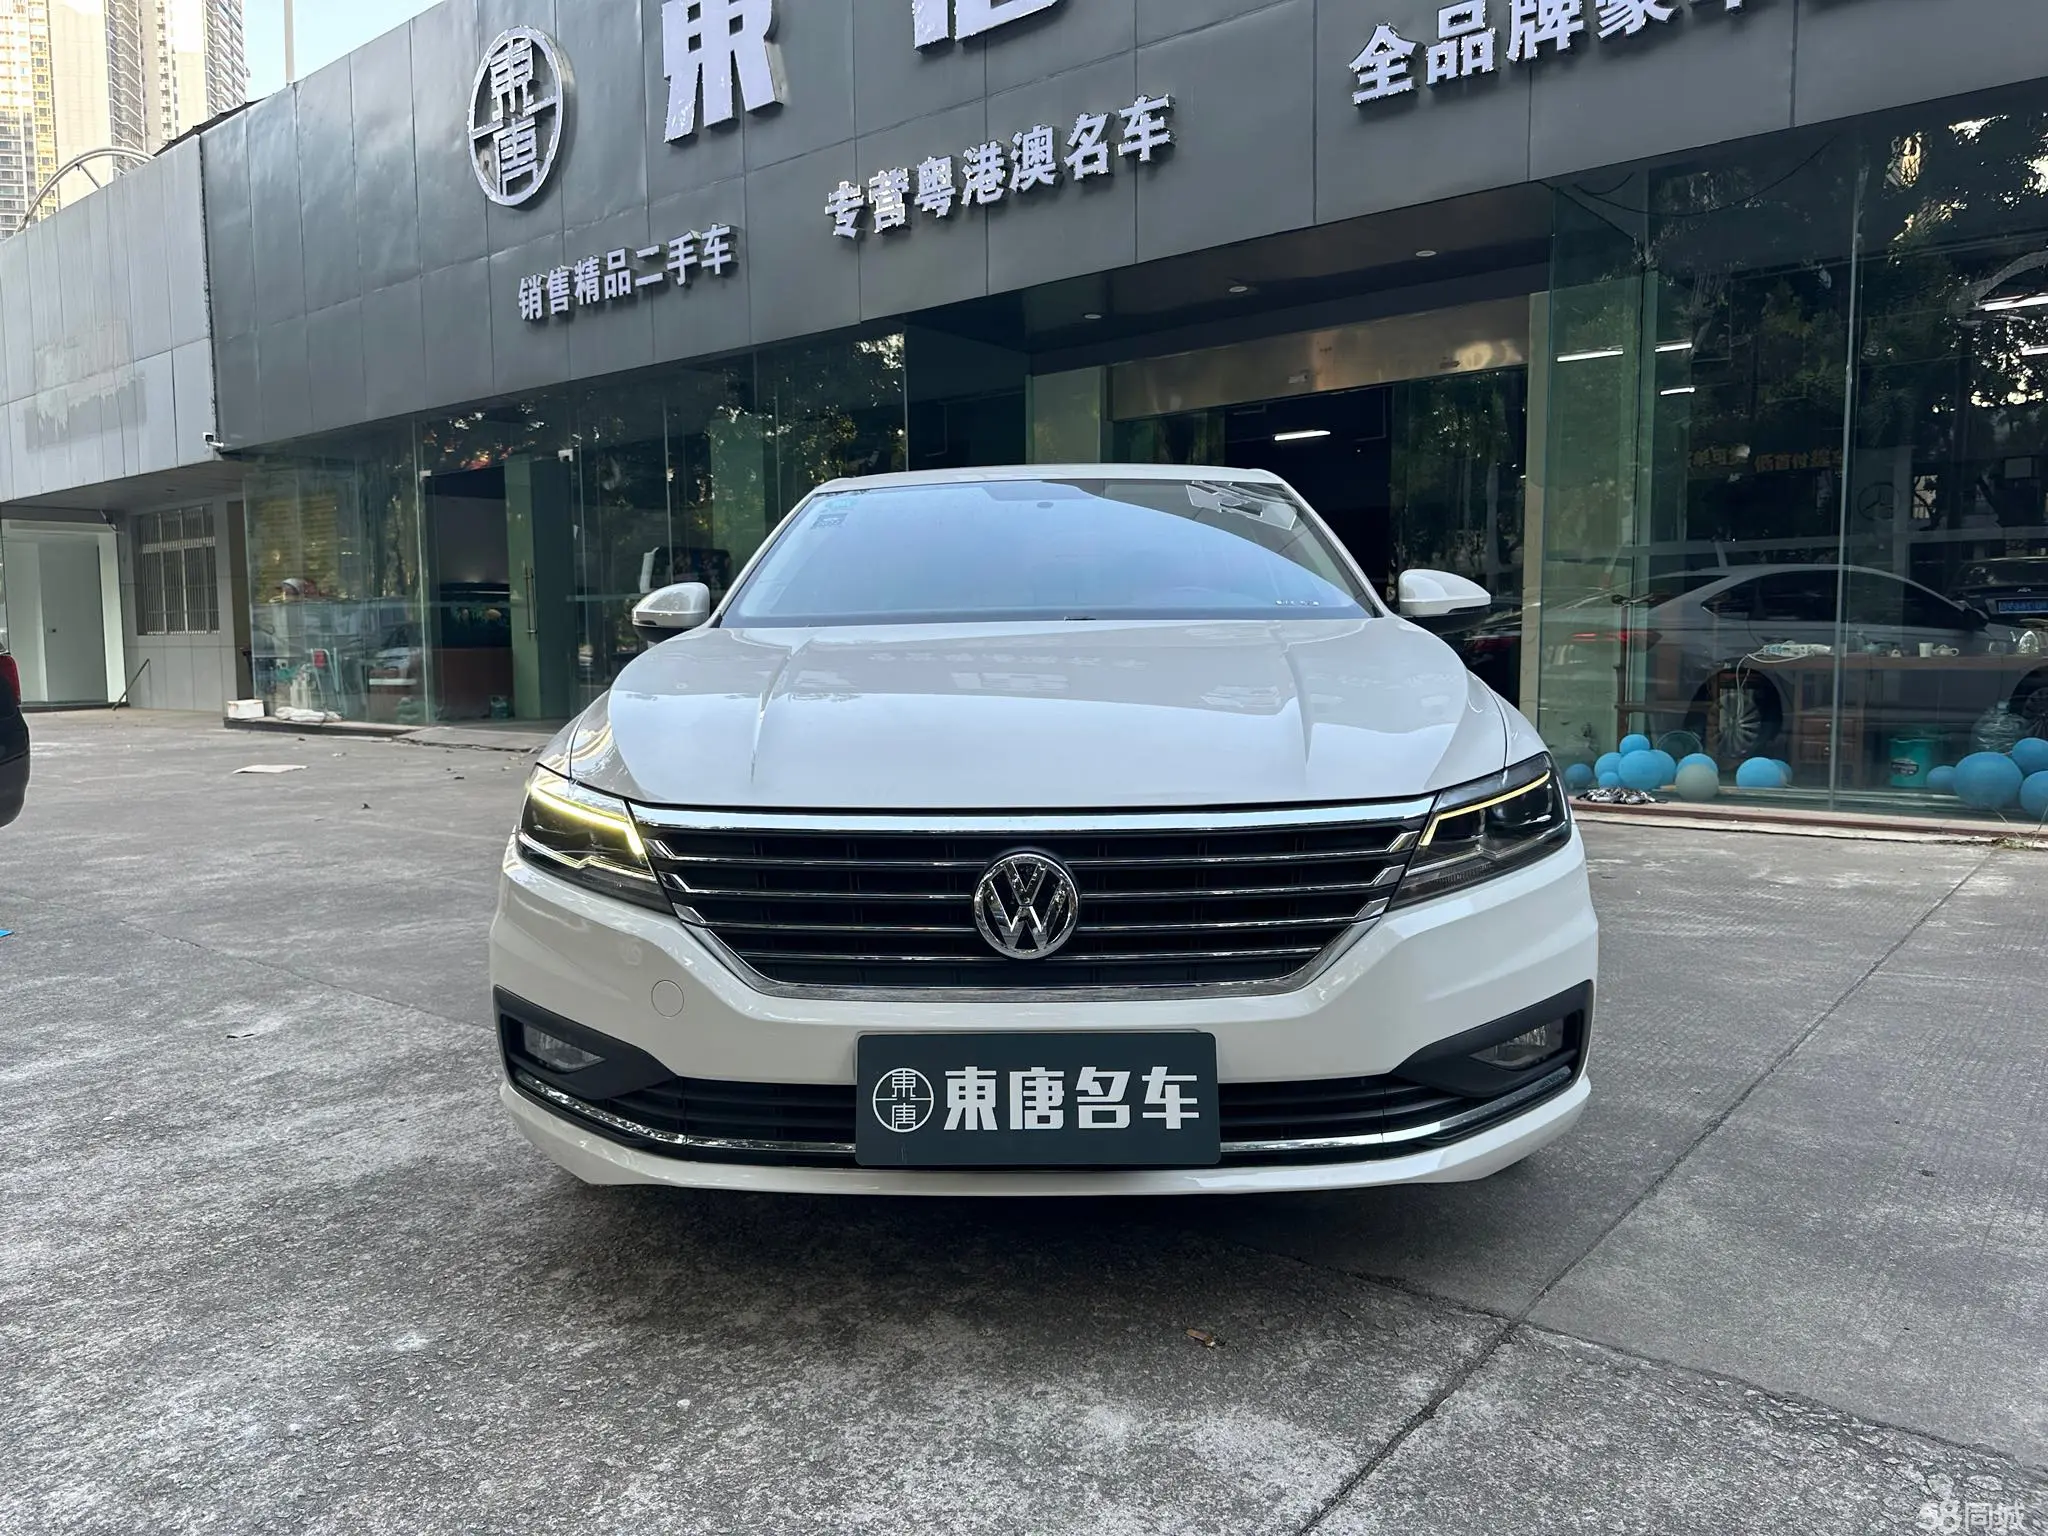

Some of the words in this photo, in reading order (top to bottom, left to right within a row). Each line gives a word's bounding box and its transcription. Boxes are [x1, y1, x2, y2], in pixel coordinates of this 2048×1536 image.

[824, 94, 1172, 239] 专营粤港澳名车
[518, 223, 732, 321] 销售精品二手车
[943, 1066, 1200, 1130] 東唐名车
